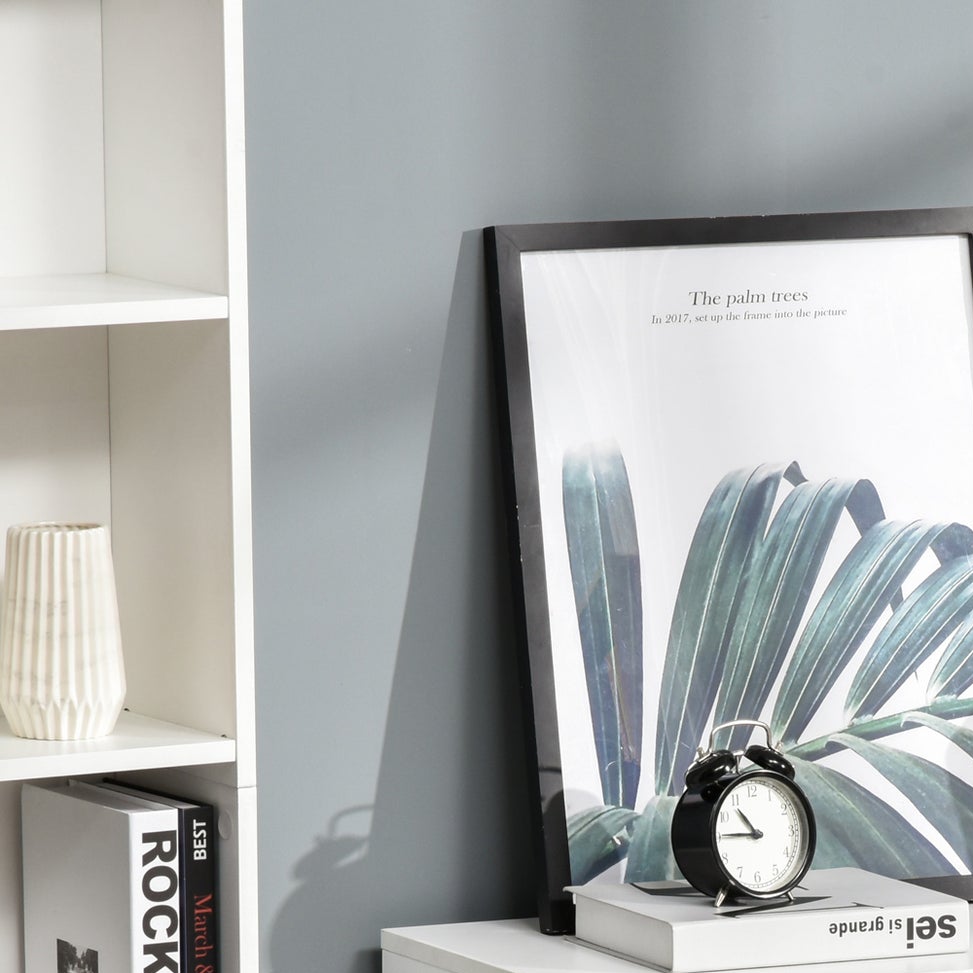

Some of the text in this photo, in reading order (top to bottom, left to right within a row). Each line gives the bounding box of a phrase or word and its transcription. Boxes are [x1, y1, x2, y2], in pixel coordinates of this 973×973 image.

[688, 289, 809, 308] The palm trees
[651, 307, 848, 324] In 2017, set up the frame into the picture
[747, 785, 757, 798] 12
[731, 793, 740, 806] 11
[781, 803, 788, 816] 2
[720, 811, 729, 823] 10
[788, 824, 795, 837] 3
[193, 819, 207, 861] BEST
[721, 852, 729, 865] 8
[783, 846, 789, 858] 4
[736, 866, 743, 878] 7
[772, 864, 779, 876] 5
[754, 871, 761, 883] 6
[194, 894, 213, 960] March
[829, 914, 957, 949] sei si grande
